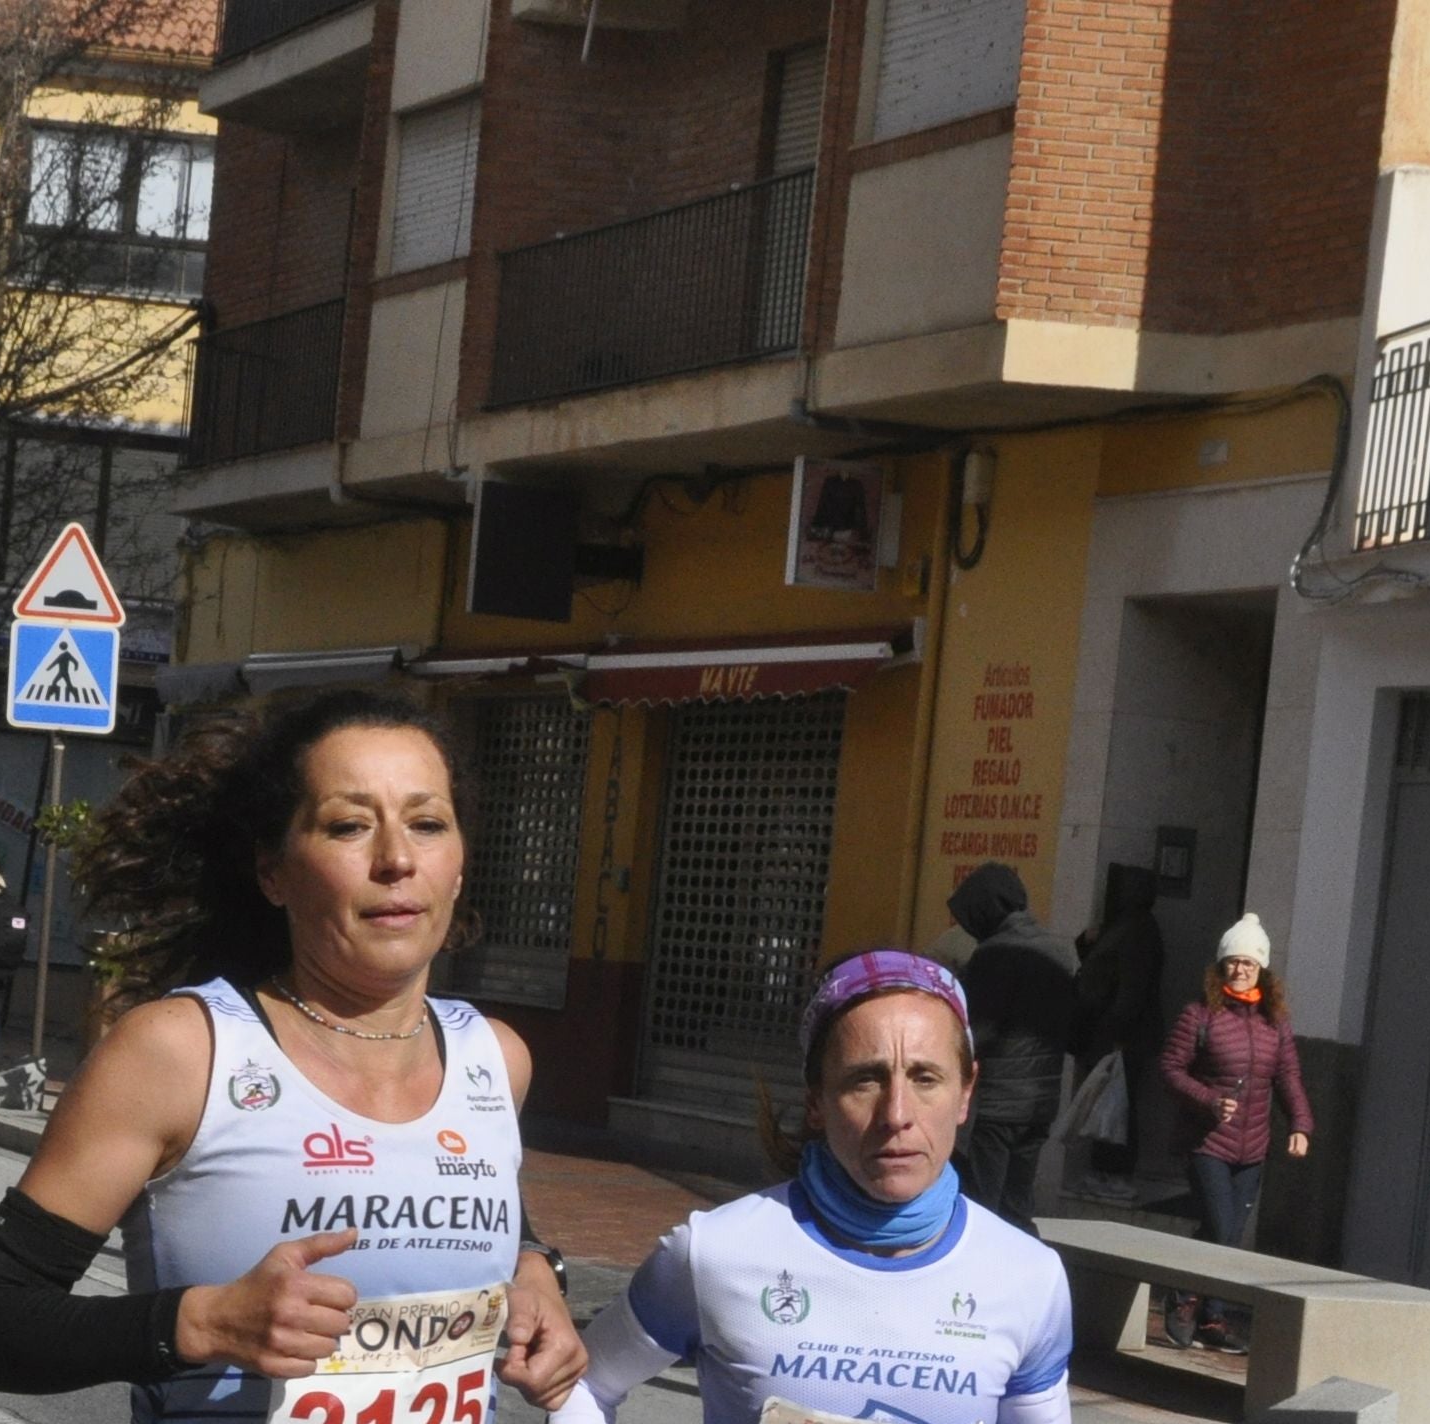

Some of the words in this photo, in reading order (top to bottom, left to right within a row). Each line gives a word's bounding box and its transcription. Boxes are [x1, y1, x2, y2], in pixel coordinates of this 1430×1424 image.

[986, 726, 1014, 754] PIEL
[971, 759, 1022, 786] REGALO
[280, 1193, 511, 1236] MARACENA
[376, 1237, 402, 1250] DE
[403, 1237, 493, 1254] ATLETISMO
[399, 1300, 461, 1319] PREMIO
[797, 1340, 840, 1354] CLUB
[844, 1345, 864, 1356] DE
[868, 1347, 957, 1364] ATLETISMO
[769, 1353, 979, 1397] MARACENA
